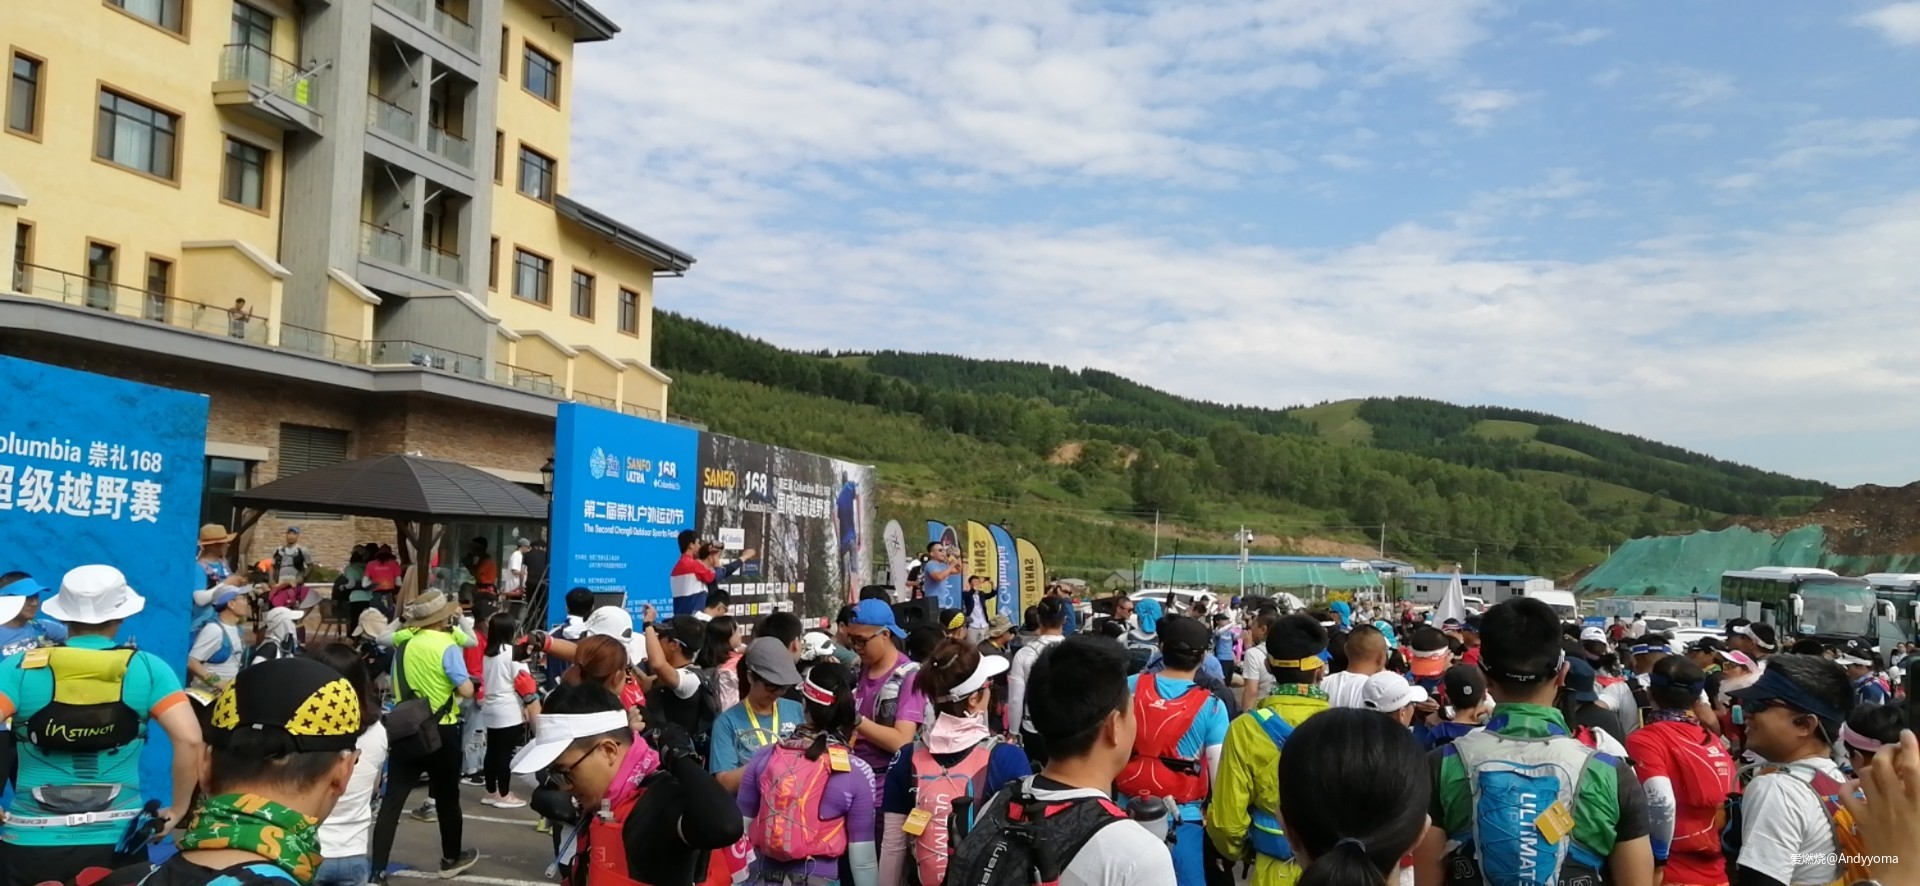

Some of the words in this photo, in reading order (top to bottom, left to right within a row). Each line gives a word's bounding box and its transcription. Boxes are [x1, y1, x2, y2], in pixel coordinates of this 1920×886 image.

[626, 456, 651, 472] SANFO
[626, 470, 646, 484] ULTRA
[704, 467, 736, 489] SANFO
[745, 471, 768, 498] 168
[703, 488, 728, 508] ULTRA
[584, 499, 684, 525] 第二届崇礼户外运动节
[584, 523, 595, 533] The
[595, 524, 615, 535] Second
